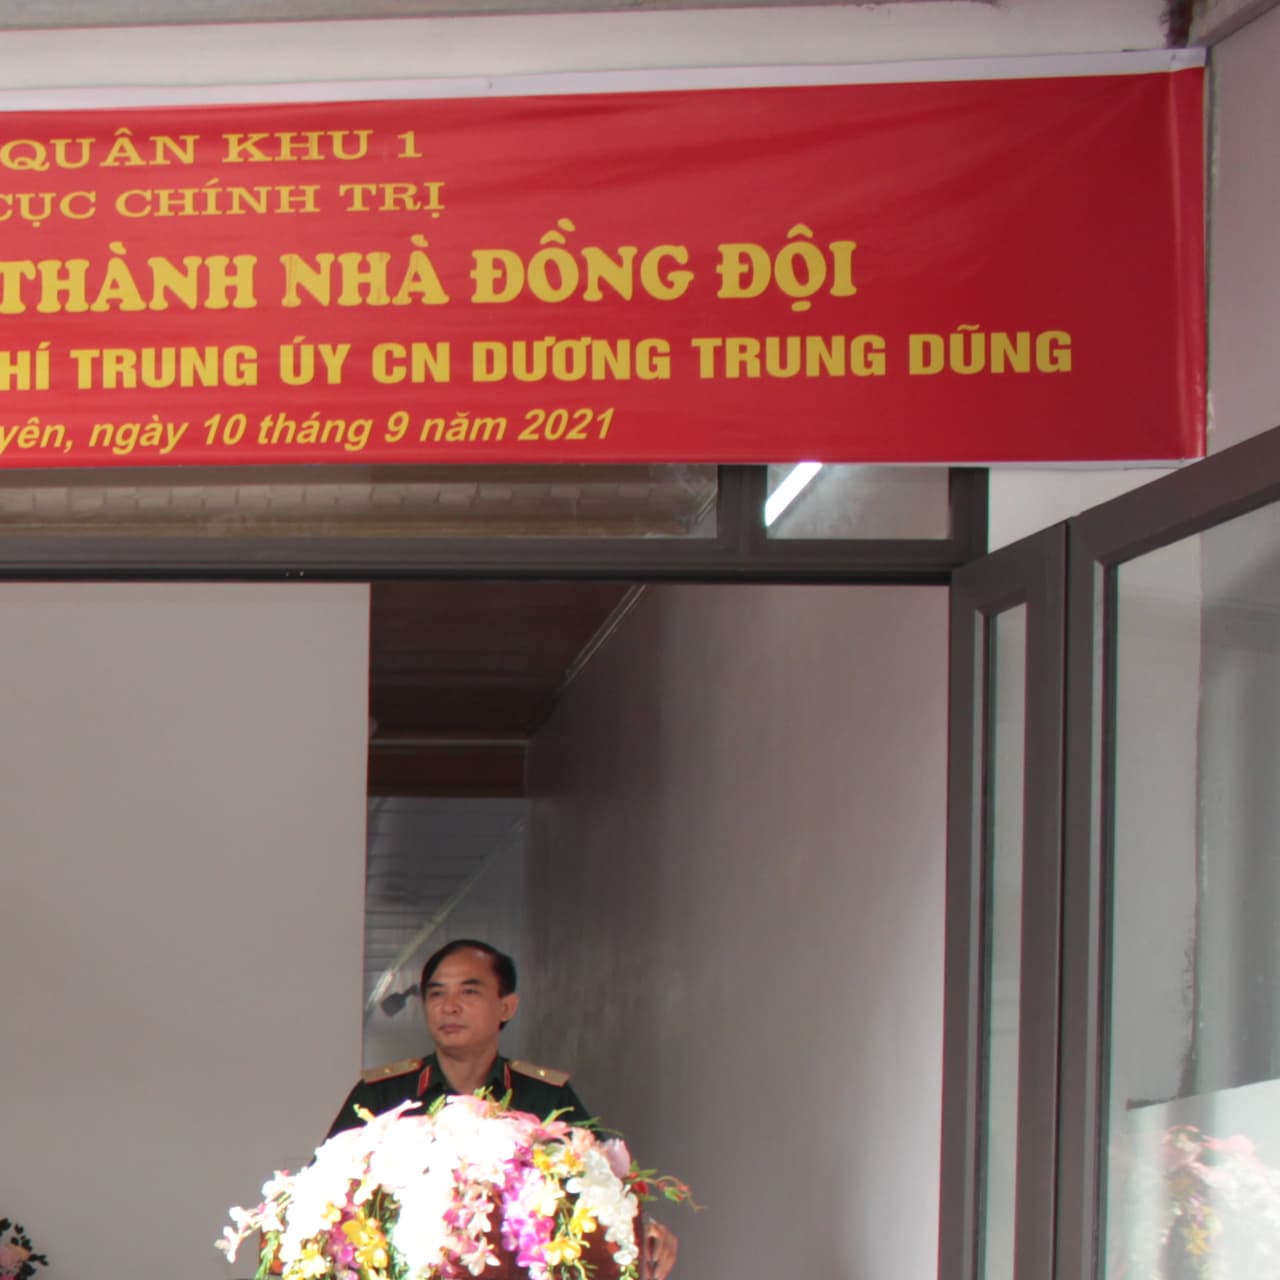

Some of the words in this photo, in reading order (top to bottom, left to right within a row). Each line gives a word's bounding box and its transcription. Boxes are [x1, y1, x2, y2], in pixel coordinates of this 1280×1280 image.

[0, 128, 198, 172] QUÂN
[224, 130, 372, 163] KHU
[400, 131, 422, 158] 1
[115, 178, 320, 218] CHÍNH
[339, 182, 444, 218] TRỊ
[280, 234, 449, 308] NHÀ
[470, 218, 694, 303] ĐỒNG
[716, 224, 856, 311] ĐỘI
[70, 345, 258, 389] TRUNG
[280, 336, 351, 385] ÚY
[372, 342, 450, 384] CN
[473, 336, 670, 382] DƯƠNG
[692, 335, 885, 378] TRUNG
[910, 325, 1071, 374] DŨNG
[89, 415, 189, 455] ngày
[204, 413, 247, 445] 10
[258, 412, 373, 452] tháng
[385, 411, 409, 442] 9
[420, 413, 507, 441] năm
[518, 408, 613, 440] 2021
